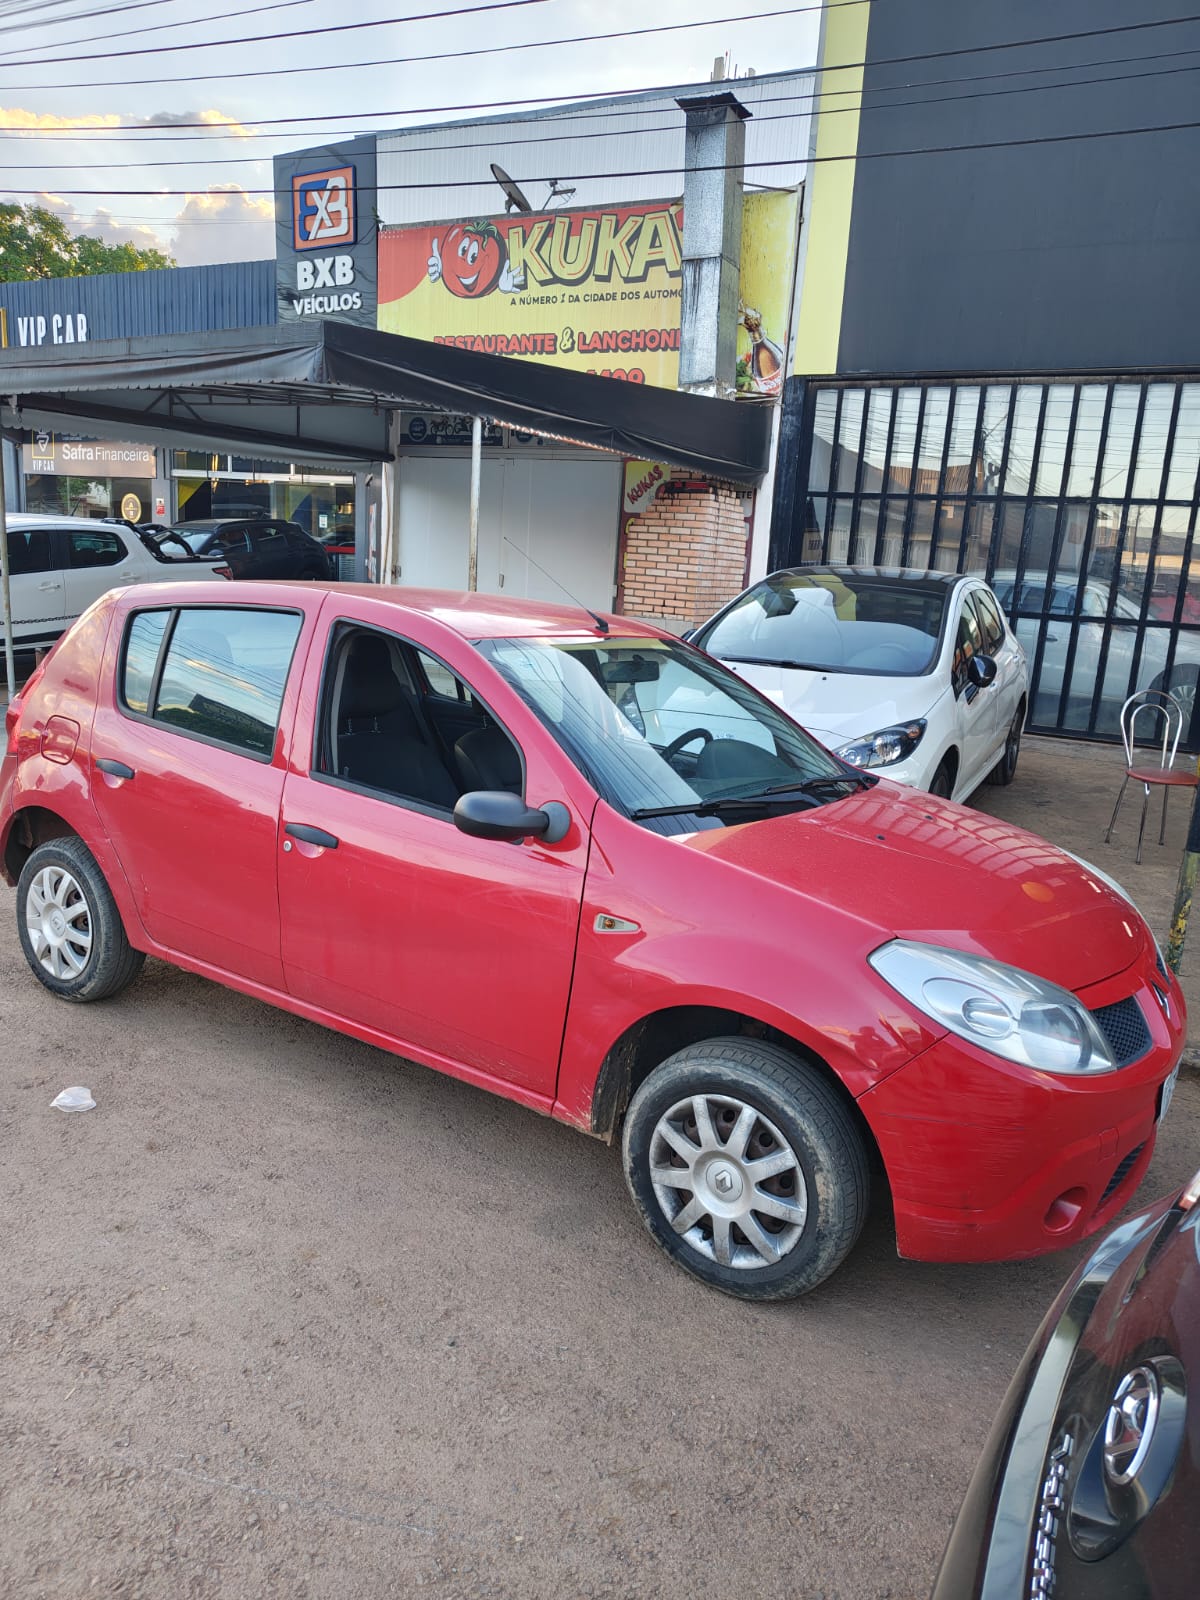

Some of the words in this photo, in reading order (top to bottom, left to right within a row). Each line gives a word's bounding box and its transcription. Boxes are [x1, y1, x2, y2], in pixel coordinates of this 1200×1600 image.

[296, 255, 354, 291] BXB
[293, 292, 362, 315] VEÍCULOS
[510, 297, 517, 306] A
[519, 294, 558, 305] NÚMERO
[560, 292, 566, 303] 1
[568, 294, 580, 303] DA
[583, 291, 617, 302] CIDADE
[620, 291, 640, 301] DOS
[17, 315, 47, 347] VIP
[52, 313, 87, 344] CAR
[560, 327, 575, 353] &
[62, 444, 94, 461] Safra
[95, 446, 149, 462] Financeira
[626, 464, 664, 504] KUKAS
